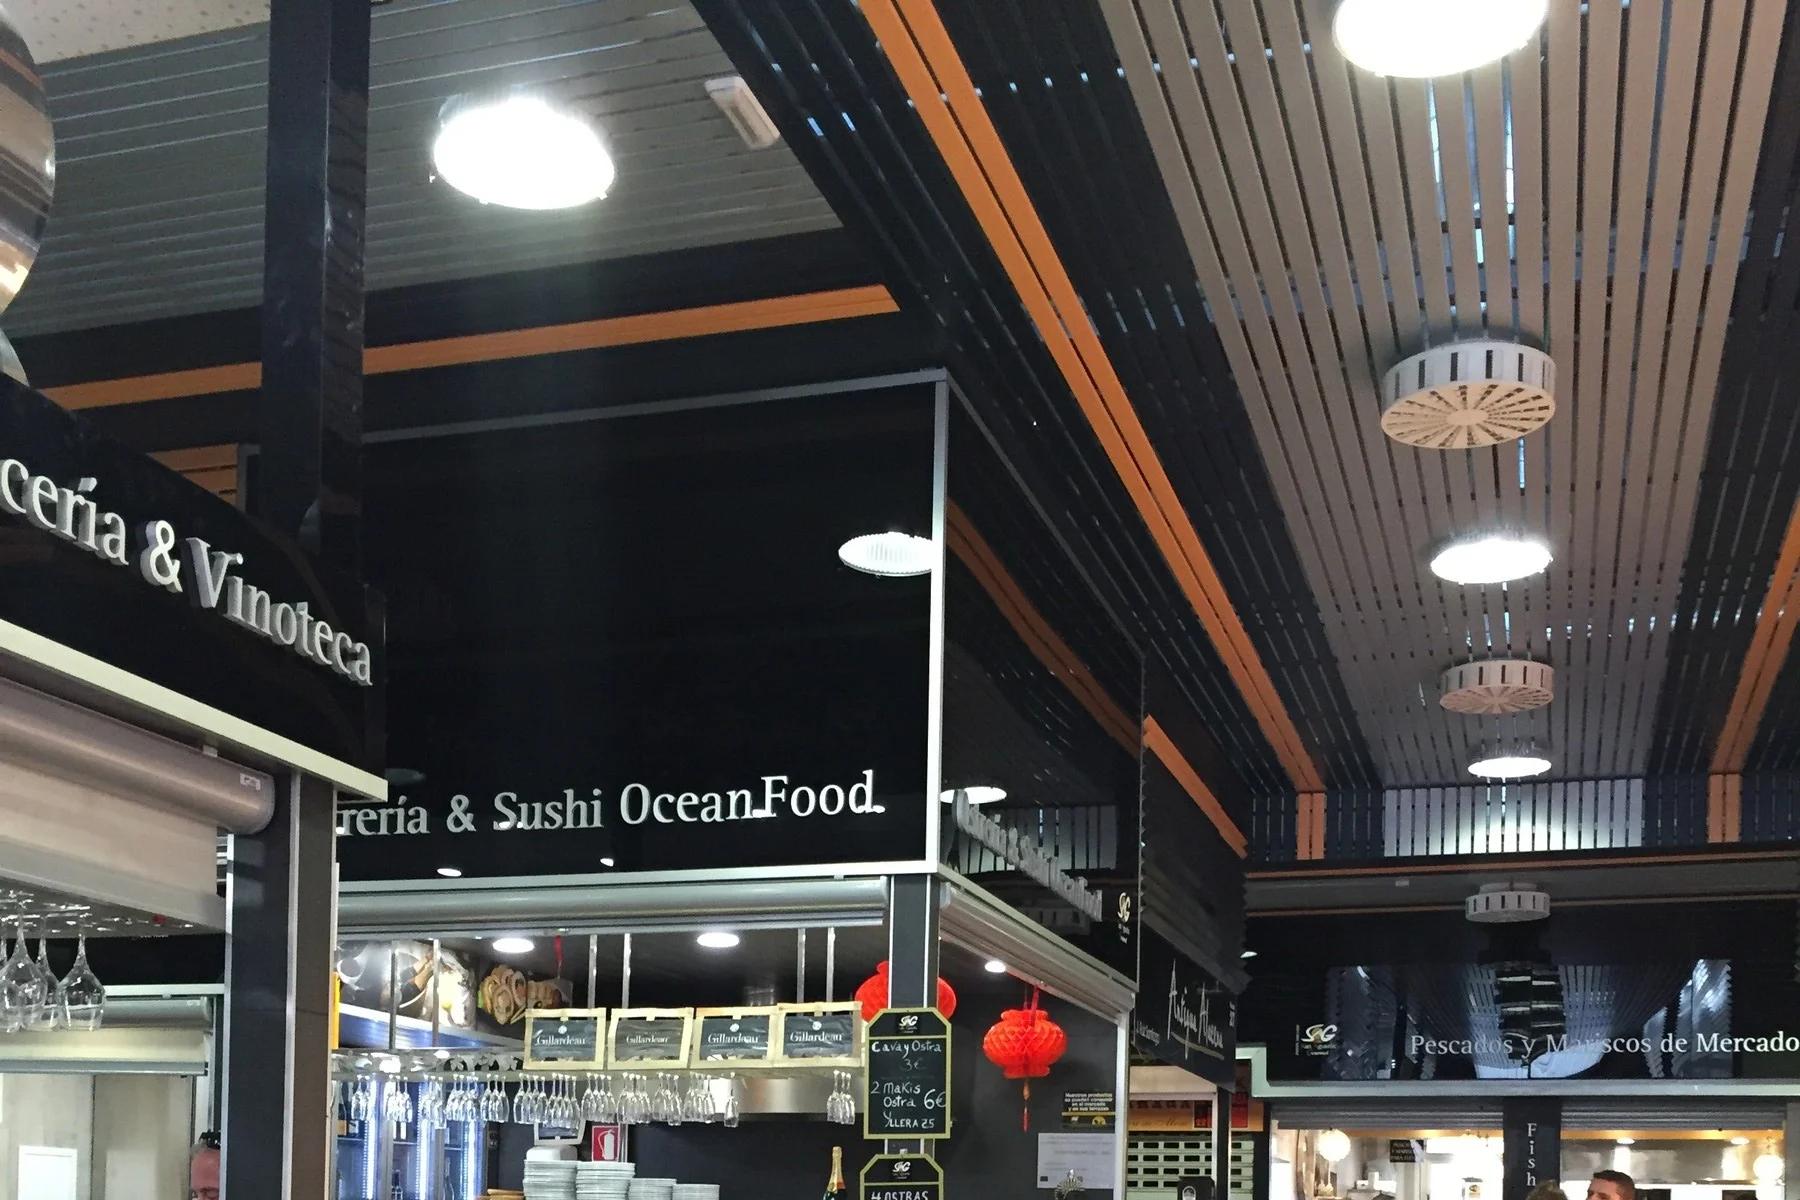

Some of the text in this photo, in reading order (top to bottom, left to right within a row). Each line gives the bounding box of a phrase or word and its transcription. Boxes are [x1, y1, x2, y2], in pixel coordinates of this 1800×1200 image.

[140, 520, 183, 592] &
[186, 537, 373, 686] Vinoteca
[446, 794, 477, 833] &
[493, 788, 604, 831] Sushi
[790, 1031, 842, 1043] Gillardeau
[871, 1041, 902, 1053] Cava
[911, 1040, 942, 1053] Ostra
[1411, 1033, 1513, 1055] Pescados
[1521, 1038, 1537, 1059] y
[1660, 1032, 1688, 1053] de
[1696, 1030, 1800, 1053] Mercado
[870, 1081, 880, 1094] 2
[883, 1095, 917, 1108] Ostra
[1526, 1122, 1538, 1187] Fish
